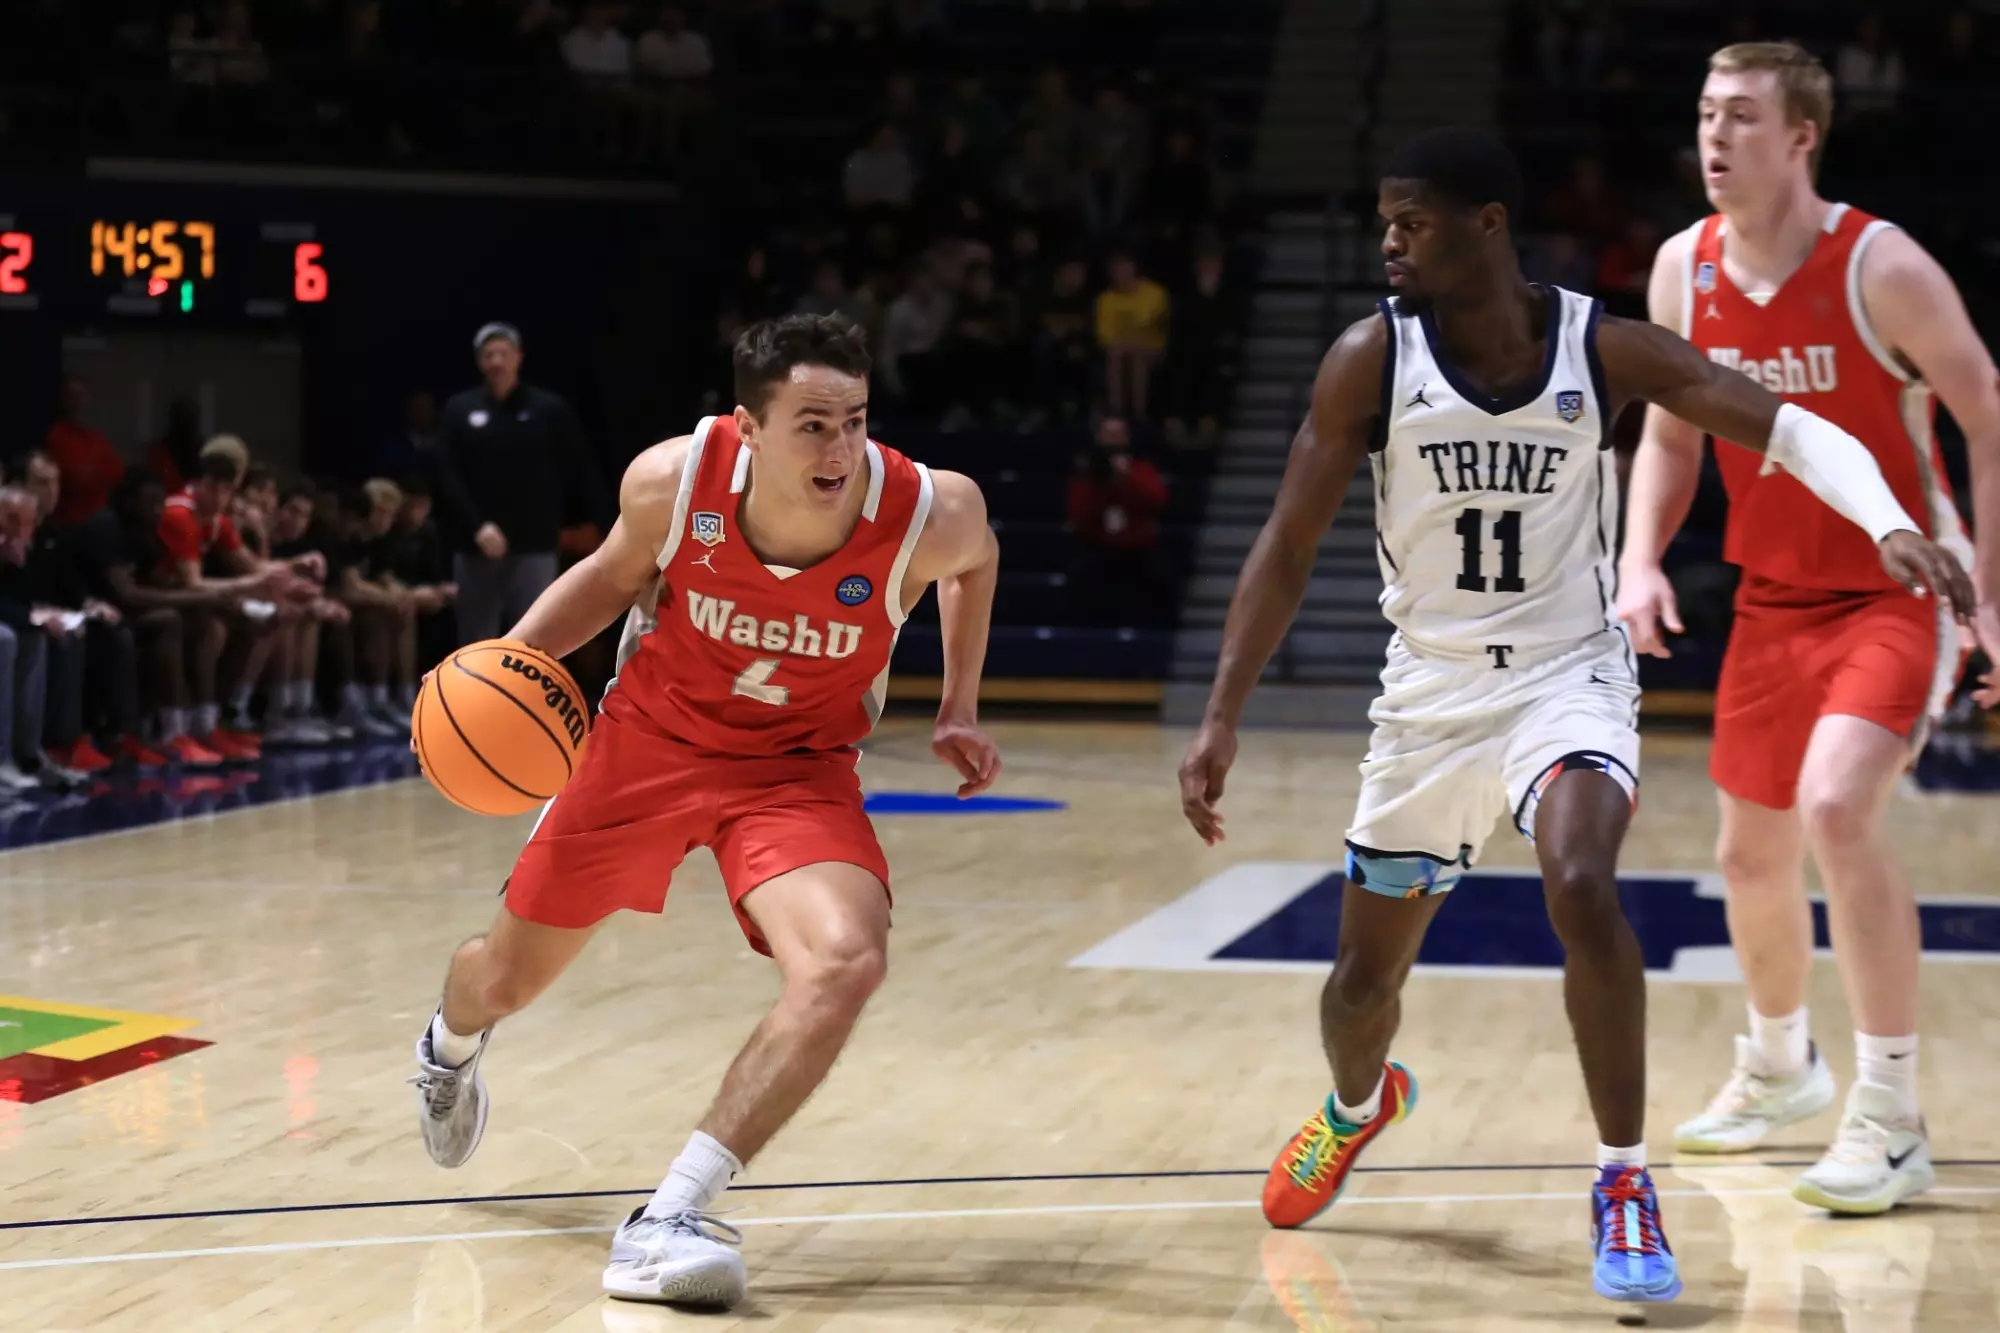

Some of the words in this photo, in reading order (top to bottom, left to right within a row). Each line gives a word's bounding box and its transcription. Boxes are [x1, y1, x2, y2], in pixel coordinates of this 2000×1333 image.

[91, 220, 215, 279] 14:57
[295, 242, 328, 301] 6
[1418, 440, 1569, 494] TRINE
[700, 520, 717, 533] 50
[1455, 507, 1526, 593] 11
[687, 588, 864, 660] WashU
[1485, 644, 1514, 669] T
[501, 654, 585, 751] Wilson
